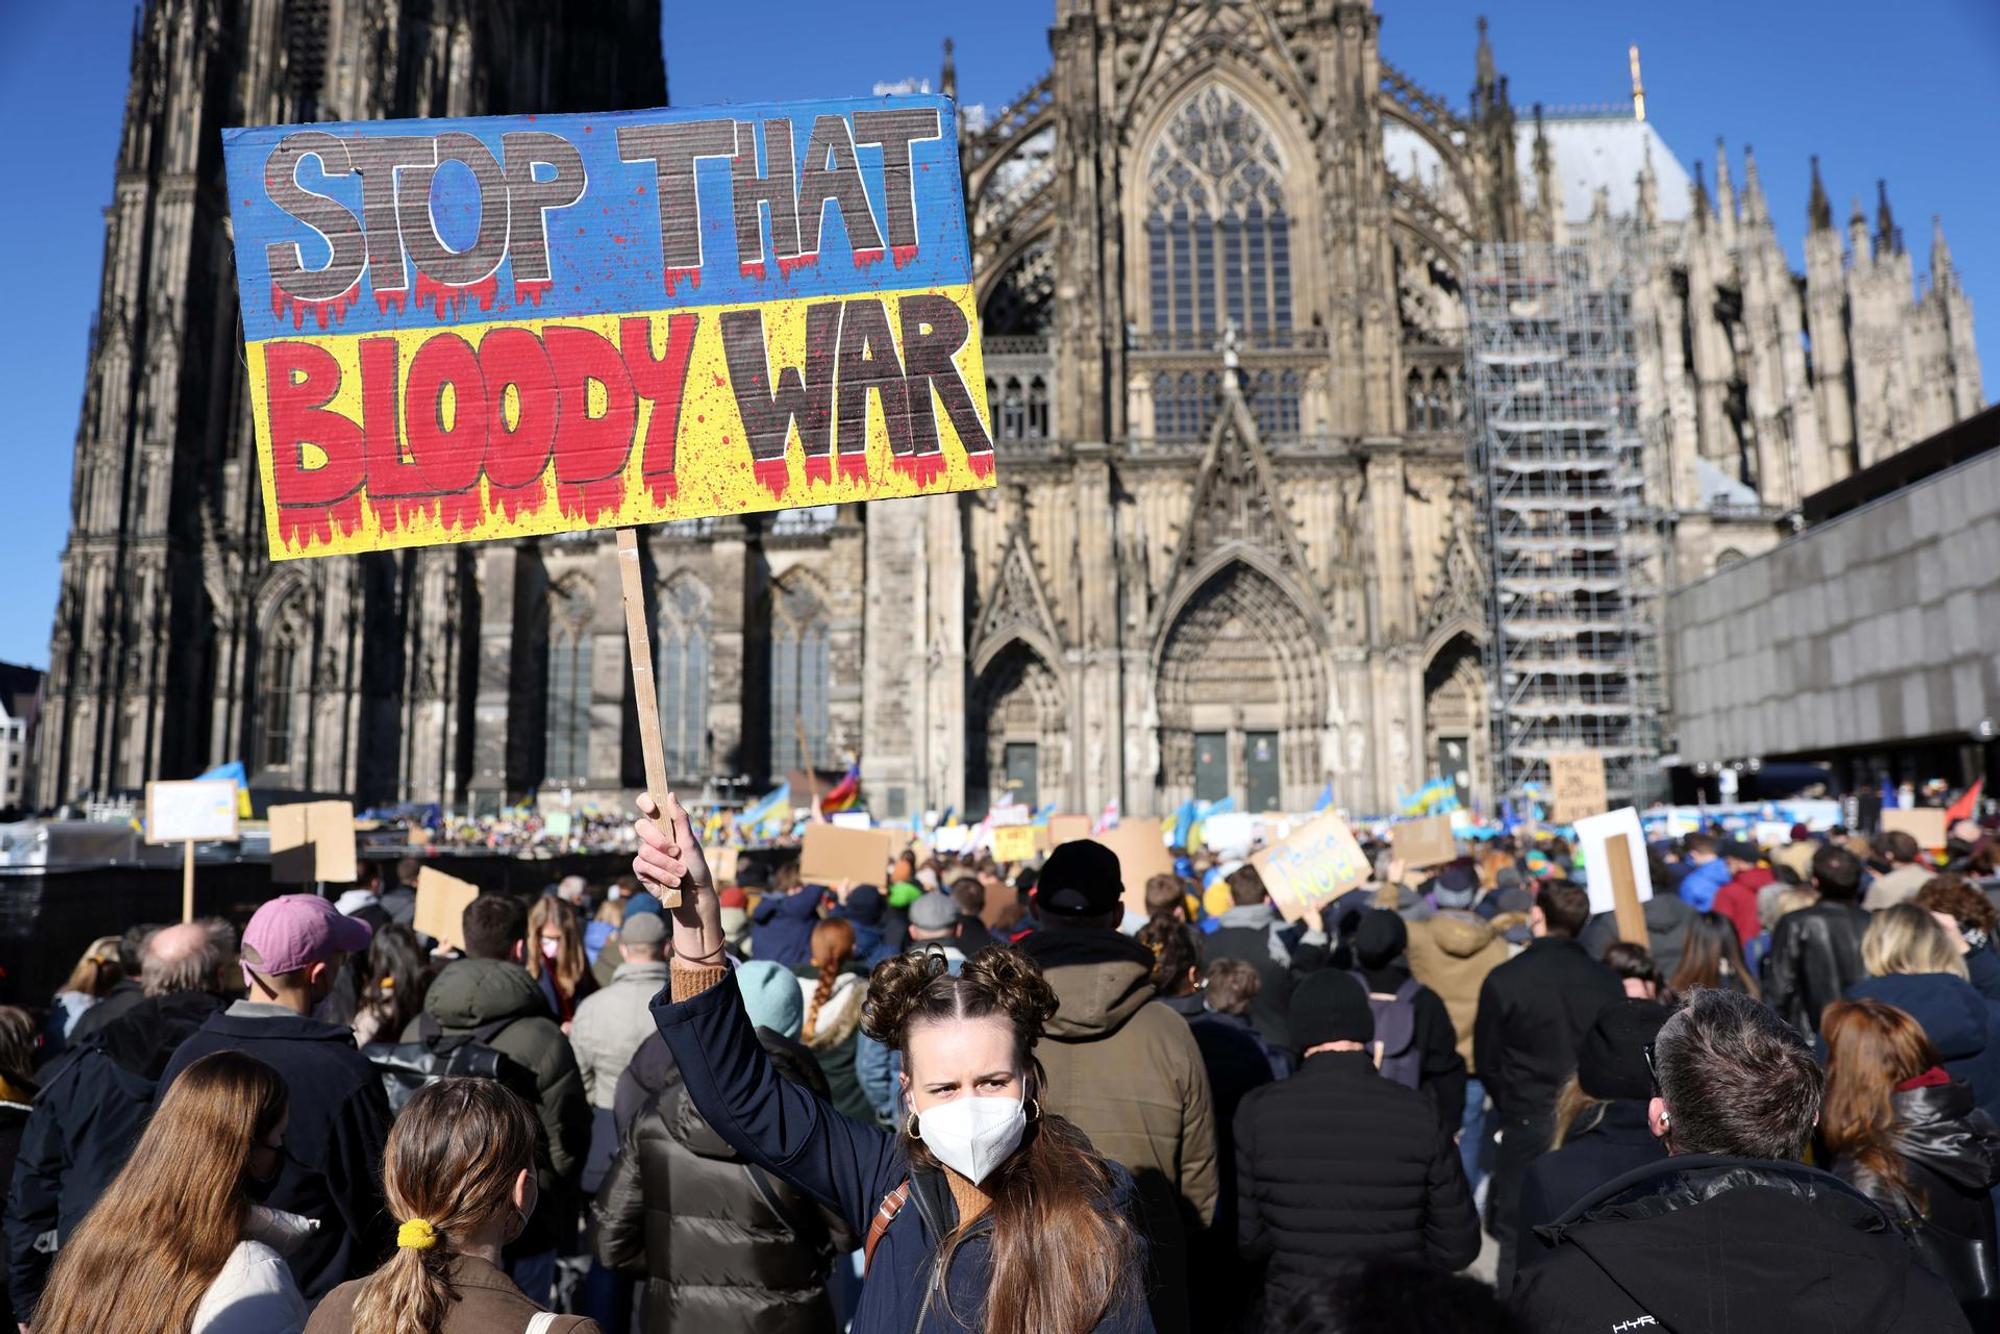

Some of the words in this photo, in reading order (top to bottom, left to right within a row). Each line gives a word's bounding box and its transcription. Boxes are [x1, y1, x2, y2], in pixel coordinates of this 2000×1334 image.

[264, 131, 588, 302] STOP
[616, 107, 942, 271] THAT
[265, 312, 699, 508] BLOODY
[720, 293, 996, 462] WAR
[1612, 1314, 1660, 1334] HYR
